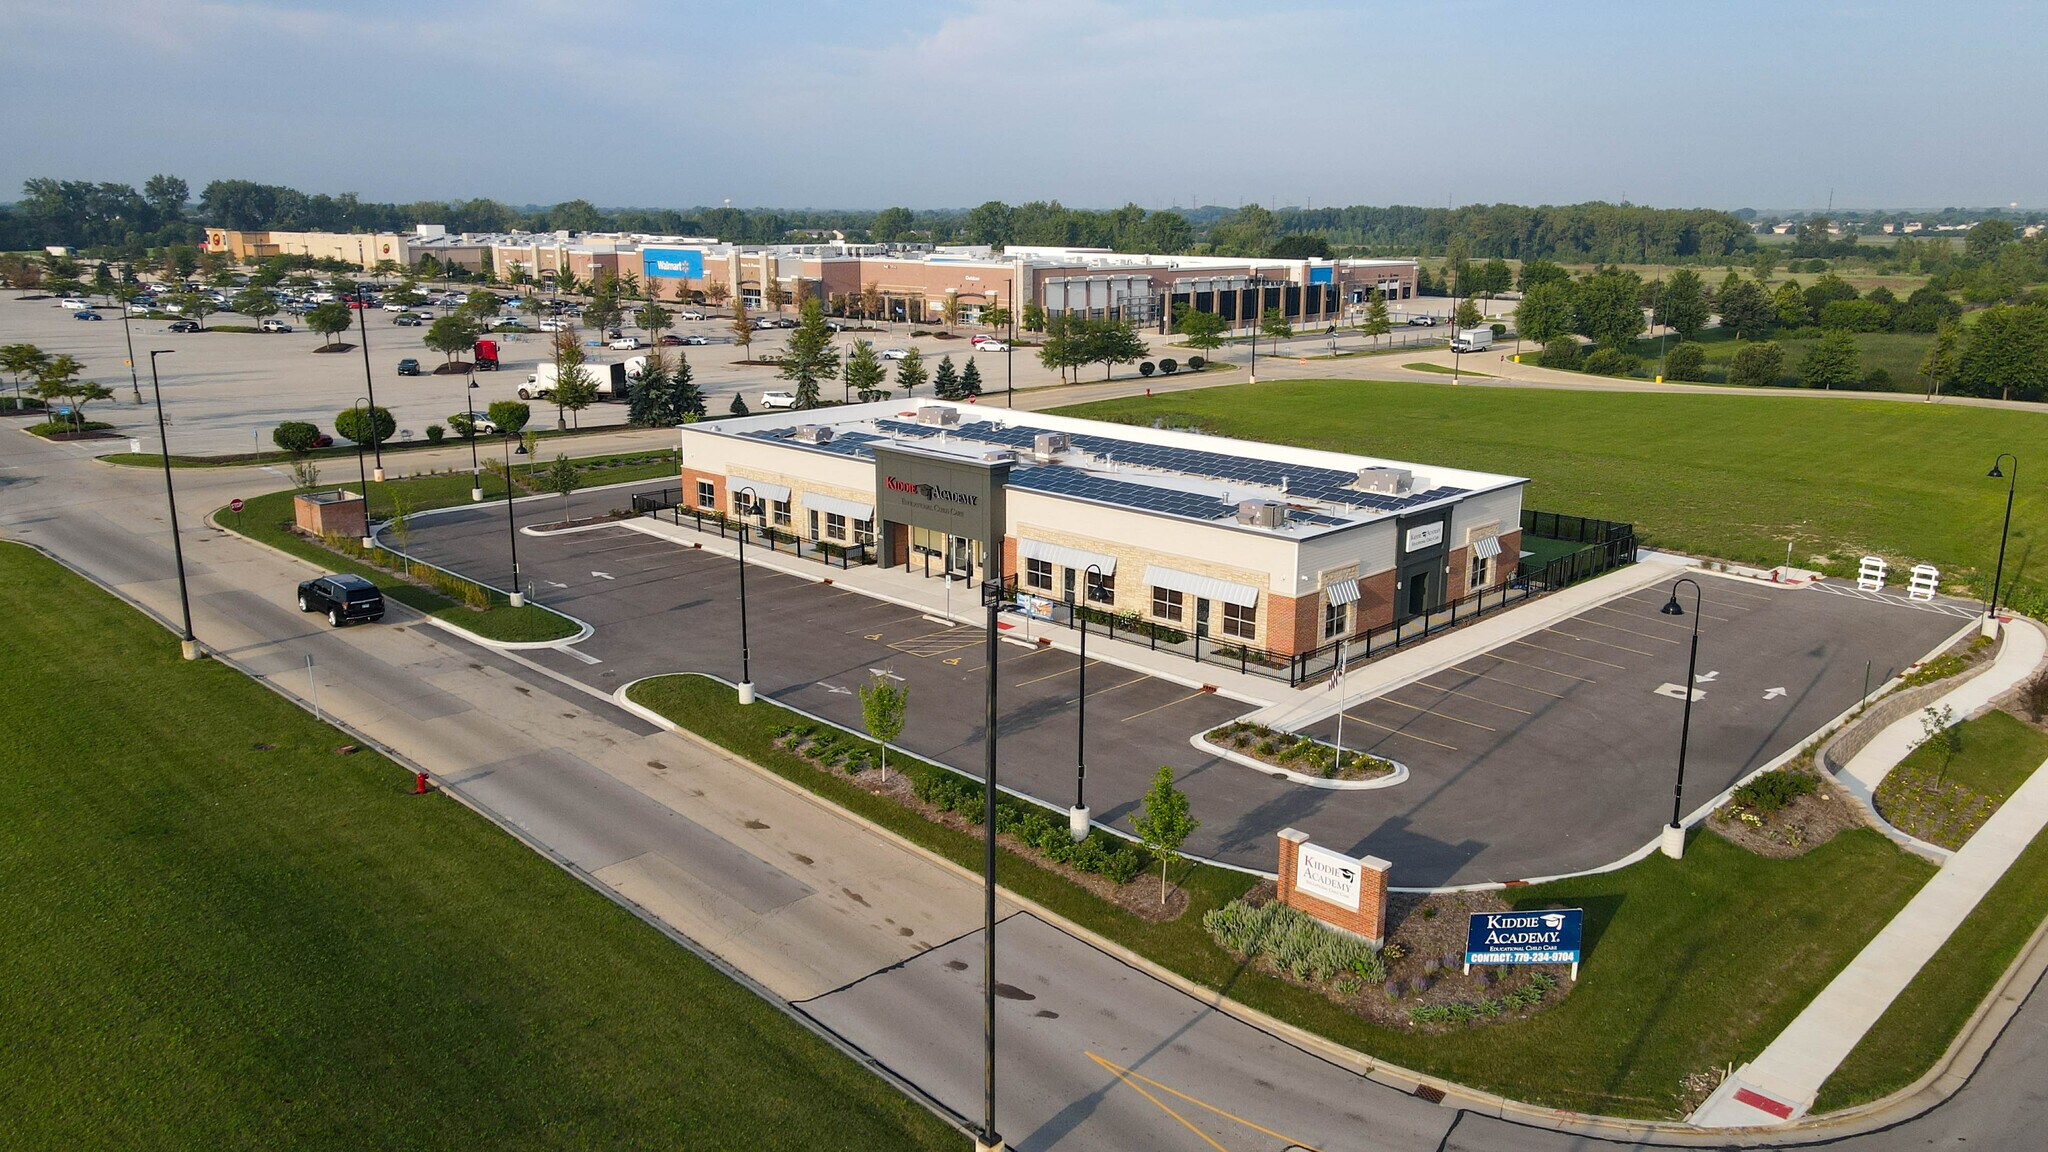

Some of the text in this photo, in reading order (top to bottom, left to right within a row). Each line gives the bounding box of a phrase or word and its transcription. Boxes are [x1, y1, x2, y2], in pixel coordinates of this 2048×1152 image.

[657, 261, 682, 271] Walmart
[885, 476, 978, 505] KIDDIE ACADEMY
[1304, 855, 1340, 878] KIDDIE
[1303, 867, 1350, 893] ACADEMY
[1486, 915, 1539, 929] KIDDIE
[1471, 952, 1574, 962] CONTACT: 779-234-9704
